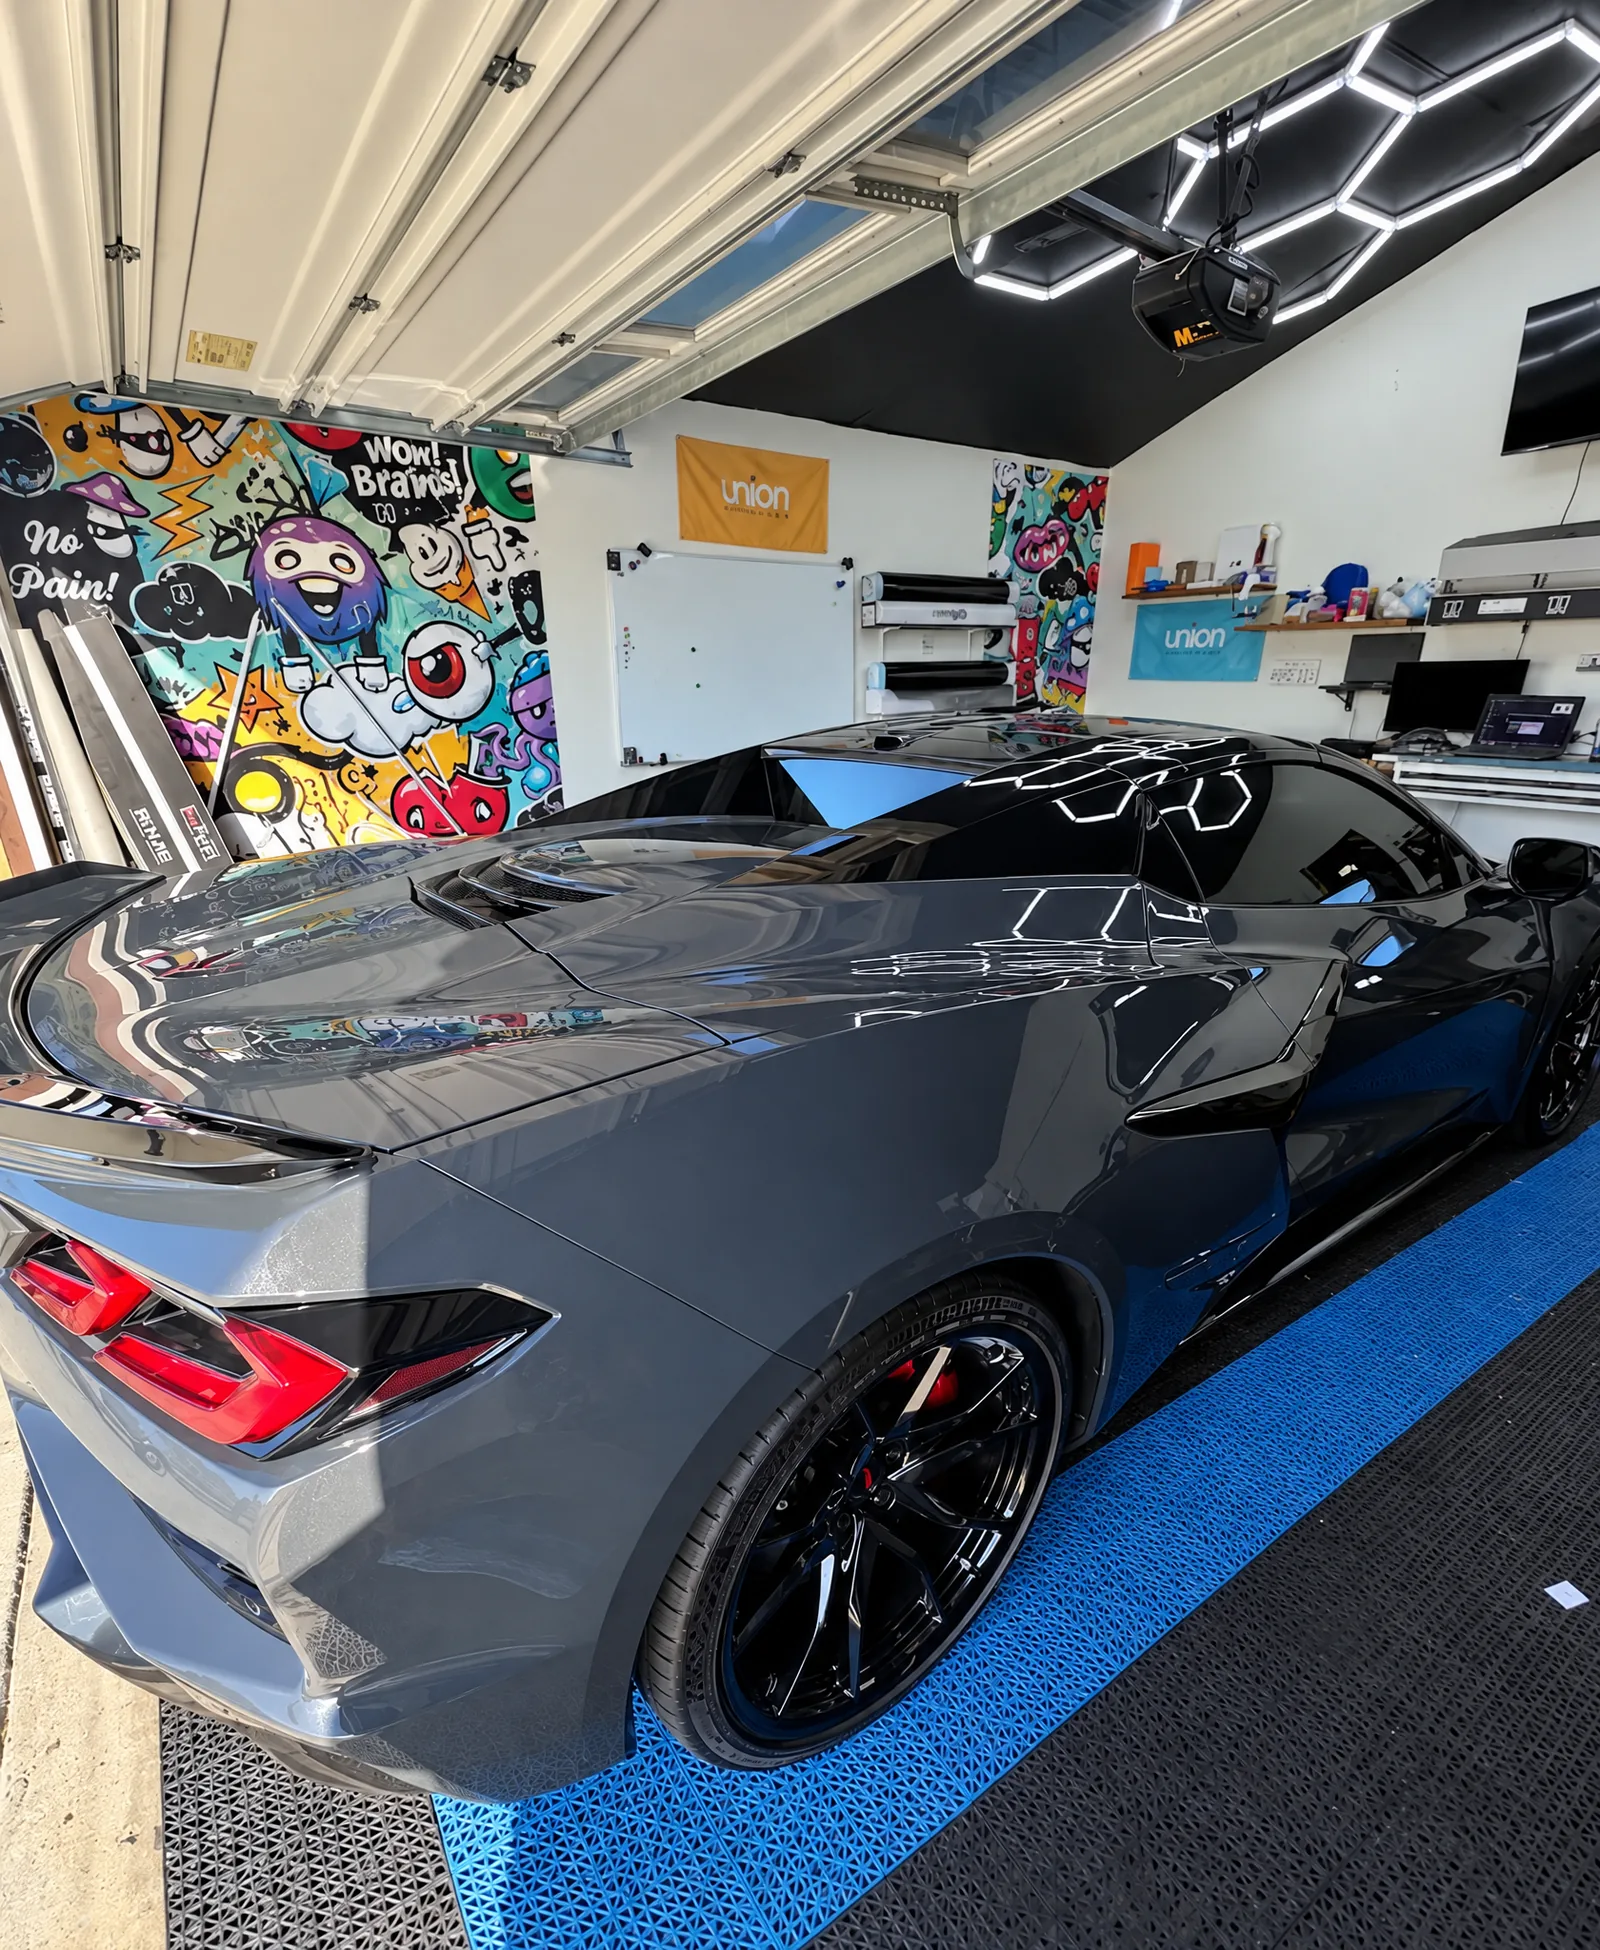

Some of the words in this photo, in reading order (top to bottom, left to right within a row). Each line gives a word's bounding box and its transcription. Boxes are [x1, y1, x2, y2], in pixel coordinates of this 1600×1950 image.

[721, 475, 789, 511] union
[24, 520, 84, 555] No
[9, 564, 119, 601] Pain!
[1165, 622, 1226, 648] union
